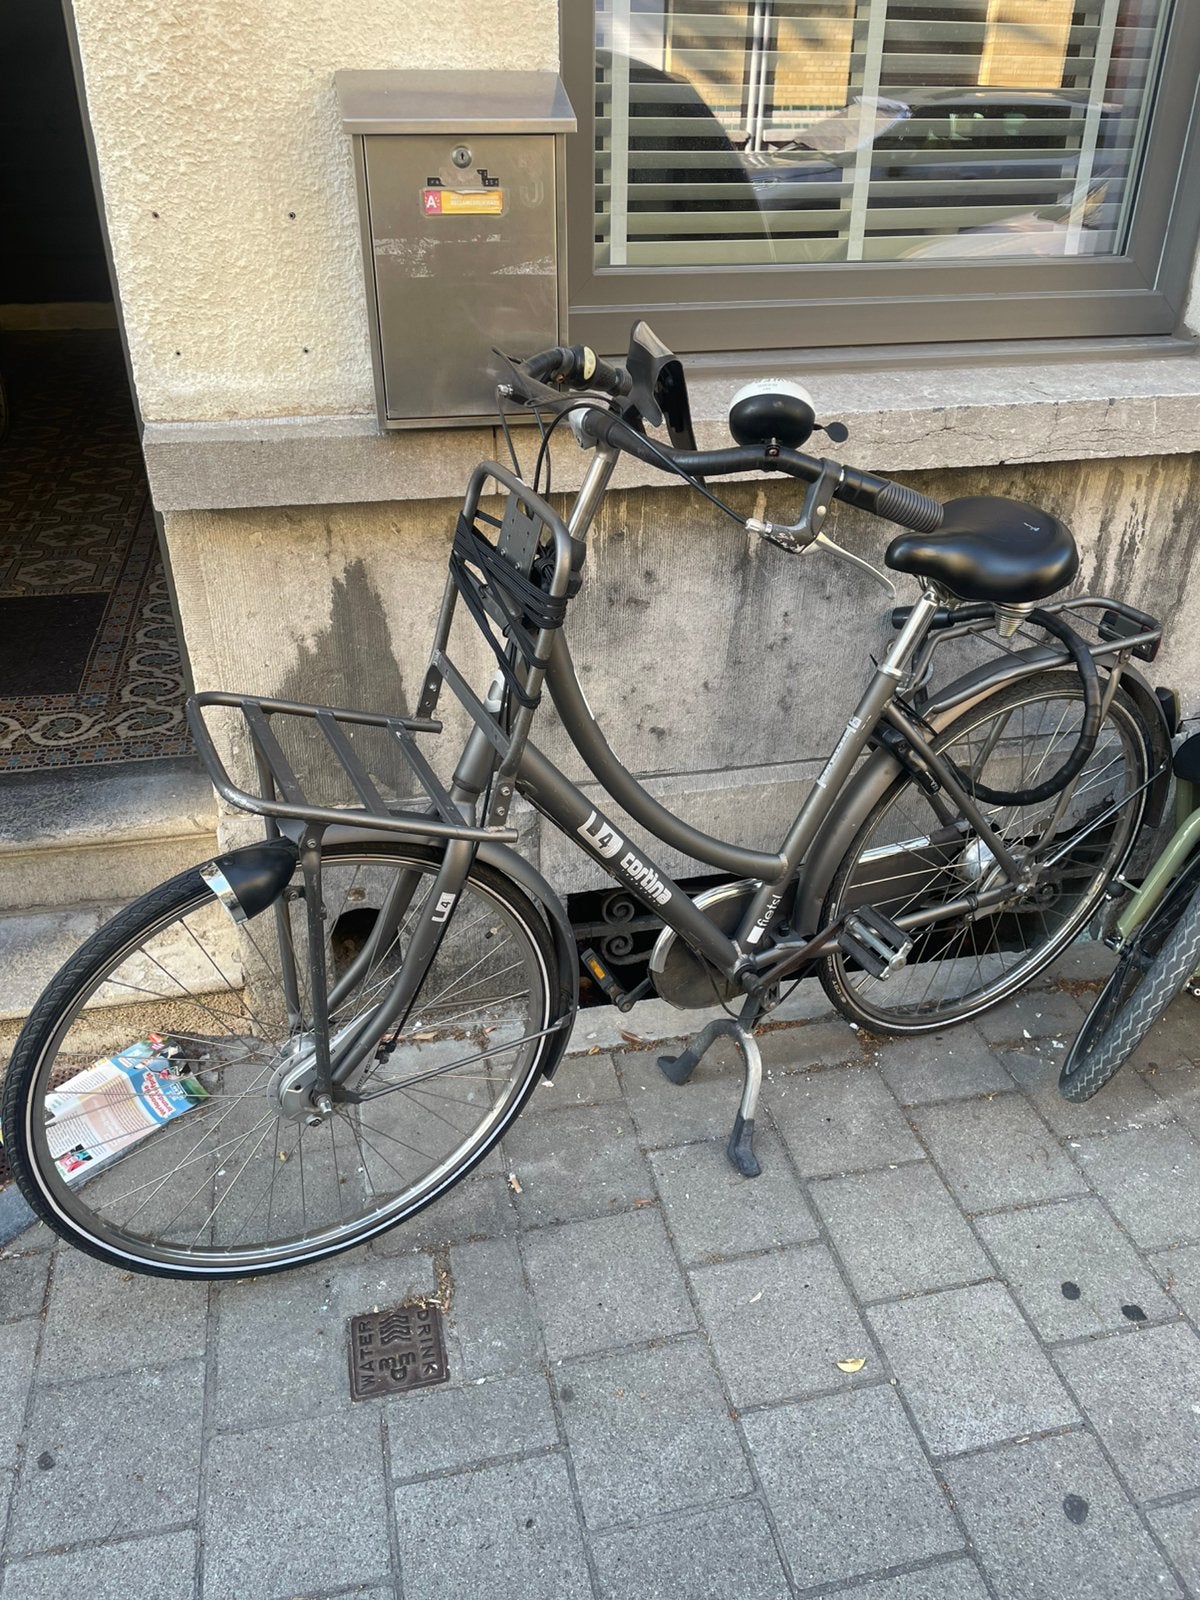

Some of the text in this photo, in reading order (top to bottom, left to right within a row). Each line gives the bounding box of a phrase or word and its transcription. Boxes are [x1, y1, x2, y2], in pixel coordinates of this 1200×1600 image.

[426, 194, 438, 208] A
[620, 852, 672, 905] cortina
[359, 1320, 375, 1391] WATER
[417, 1310, 437, 1375] DRINK
